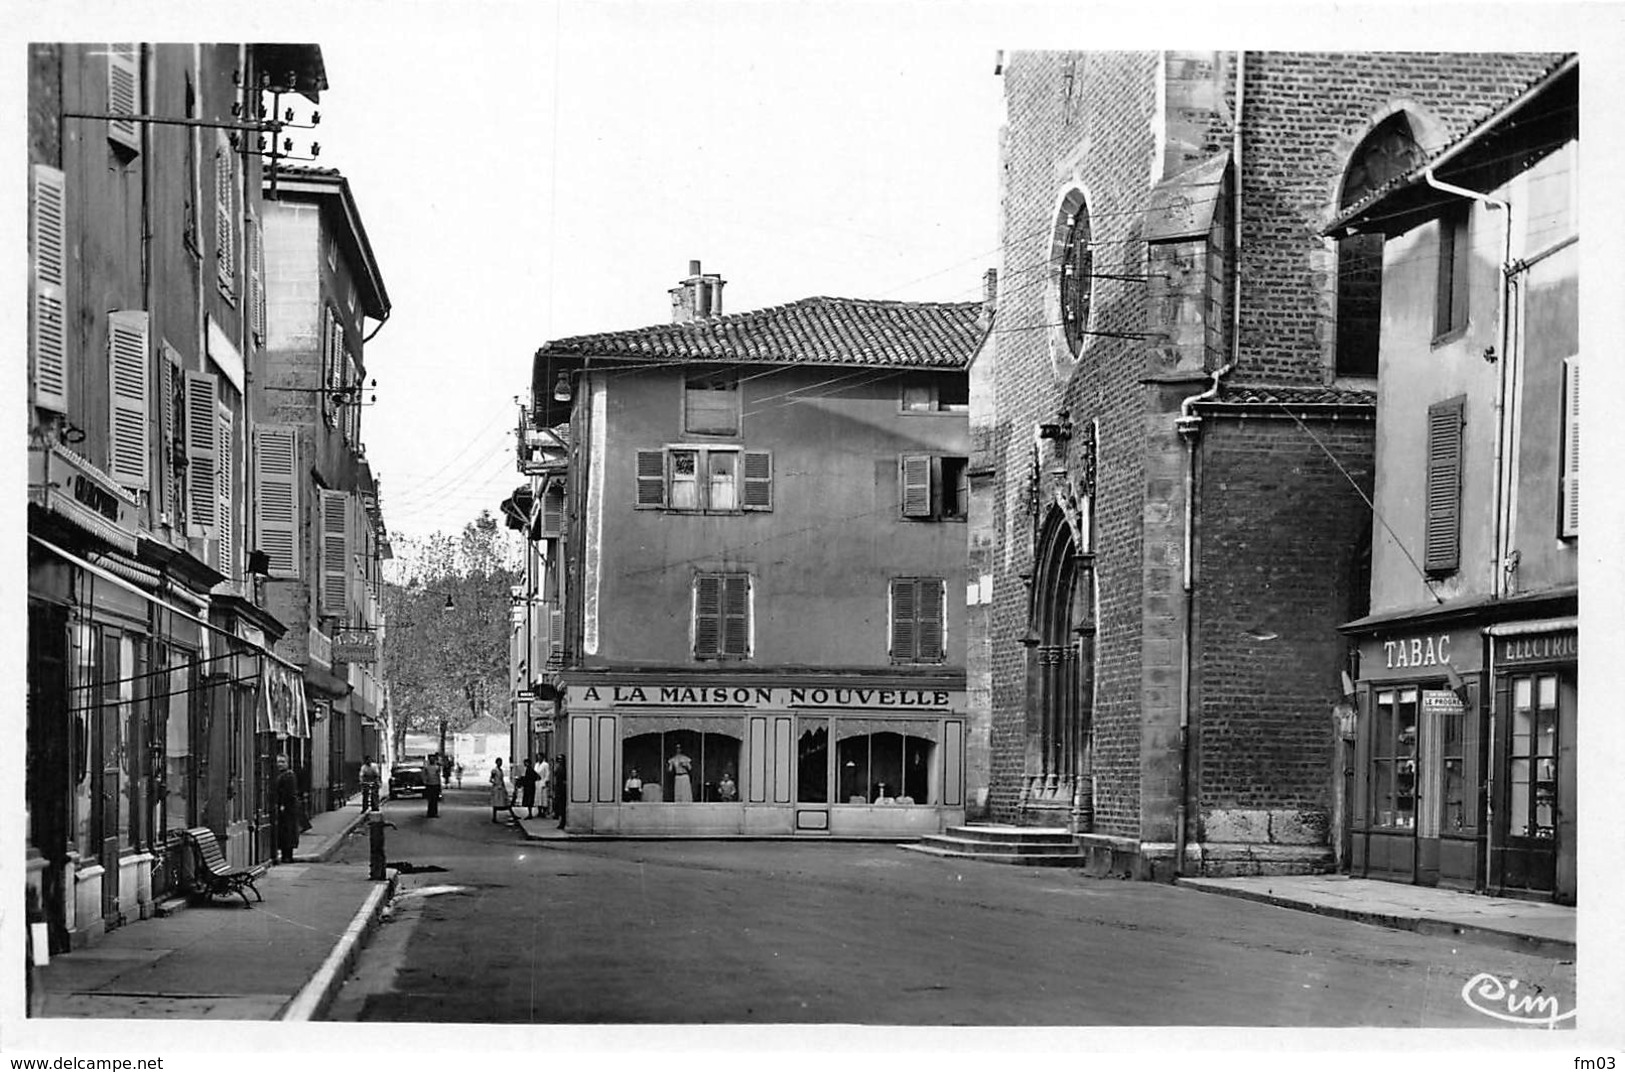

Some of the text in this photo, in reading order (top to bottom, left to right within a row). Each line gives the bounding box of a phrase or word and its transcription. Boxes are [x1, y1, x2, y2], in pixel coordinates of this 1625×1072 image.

[1384, 634, 1450, 668] TABAC
[584, 686, 950, 706] A LA MAISON NOUVELLE
